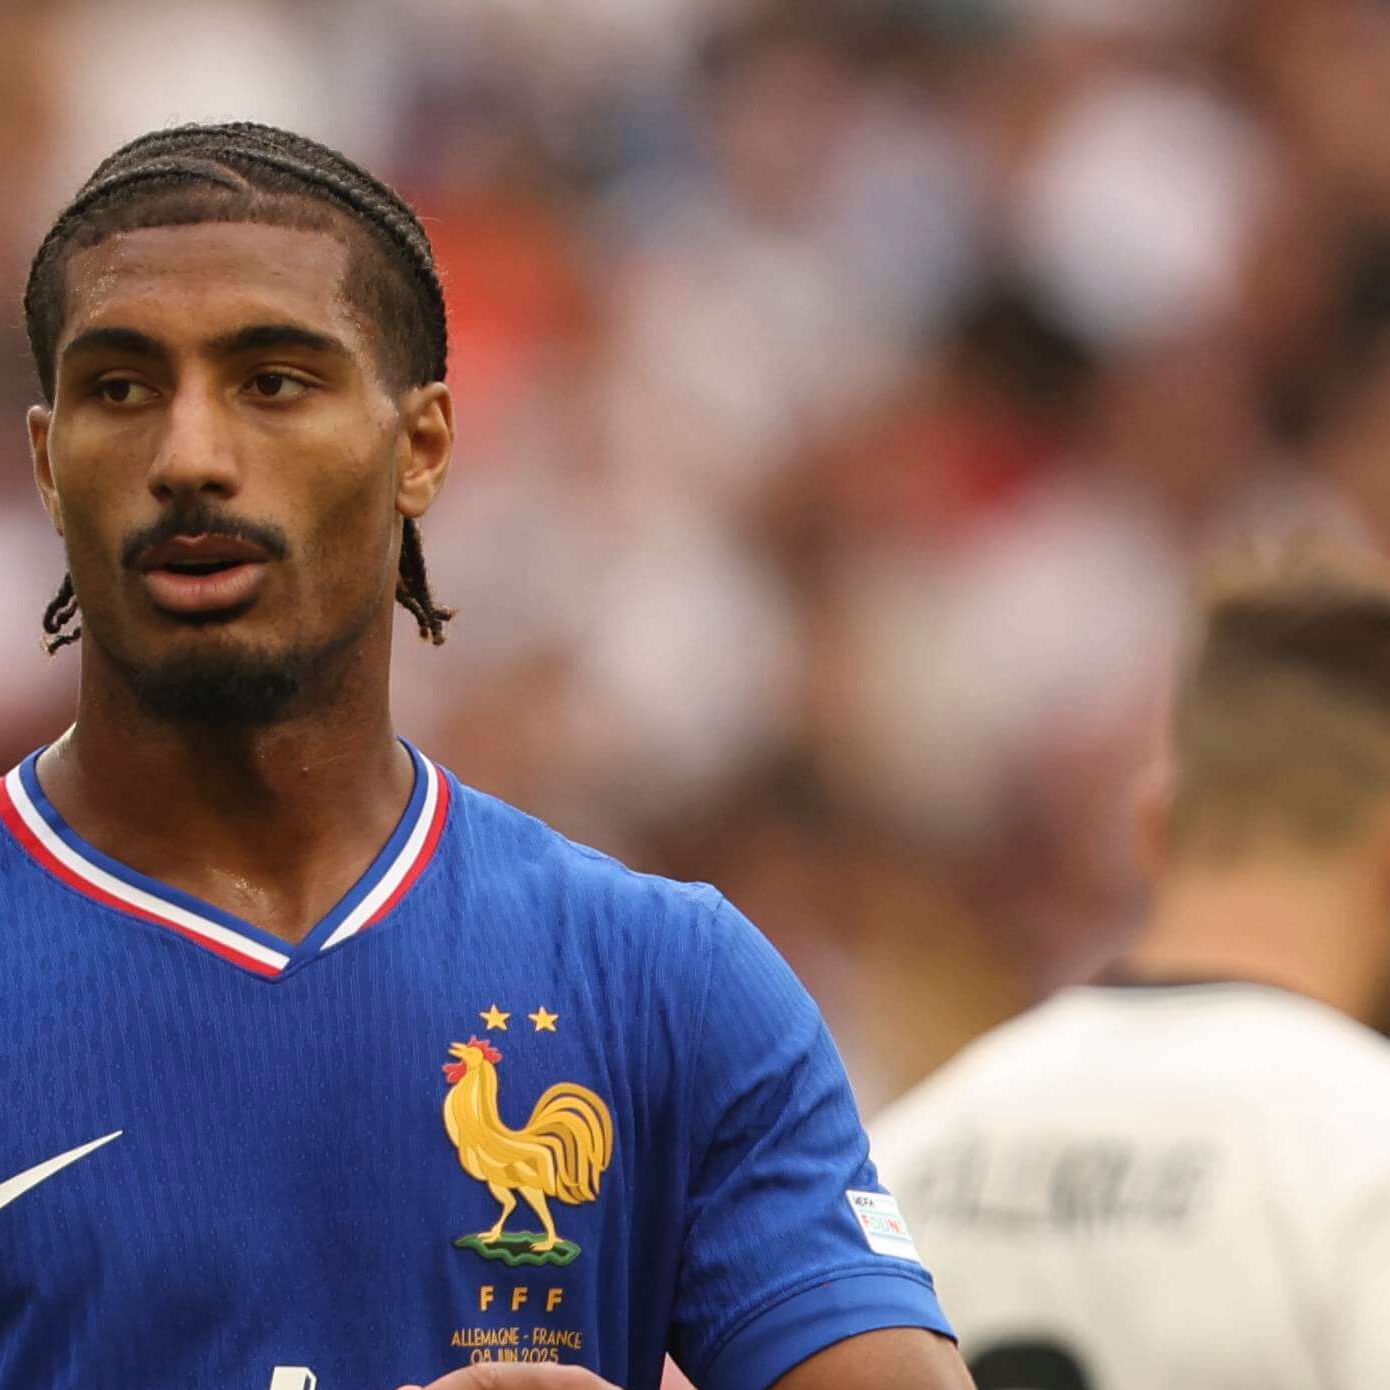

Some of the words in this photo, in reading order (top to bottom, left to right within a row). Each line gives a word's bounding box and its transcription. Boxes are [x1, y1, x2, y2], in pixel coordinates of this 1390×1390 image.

[451, 1327, 519, 1348] ALLEMAGNE
[532, 1327, 582, 1349] FRANCE
[471, 1349, 491, 1363] 08
[521, 1348, 560, 1363] 2025
